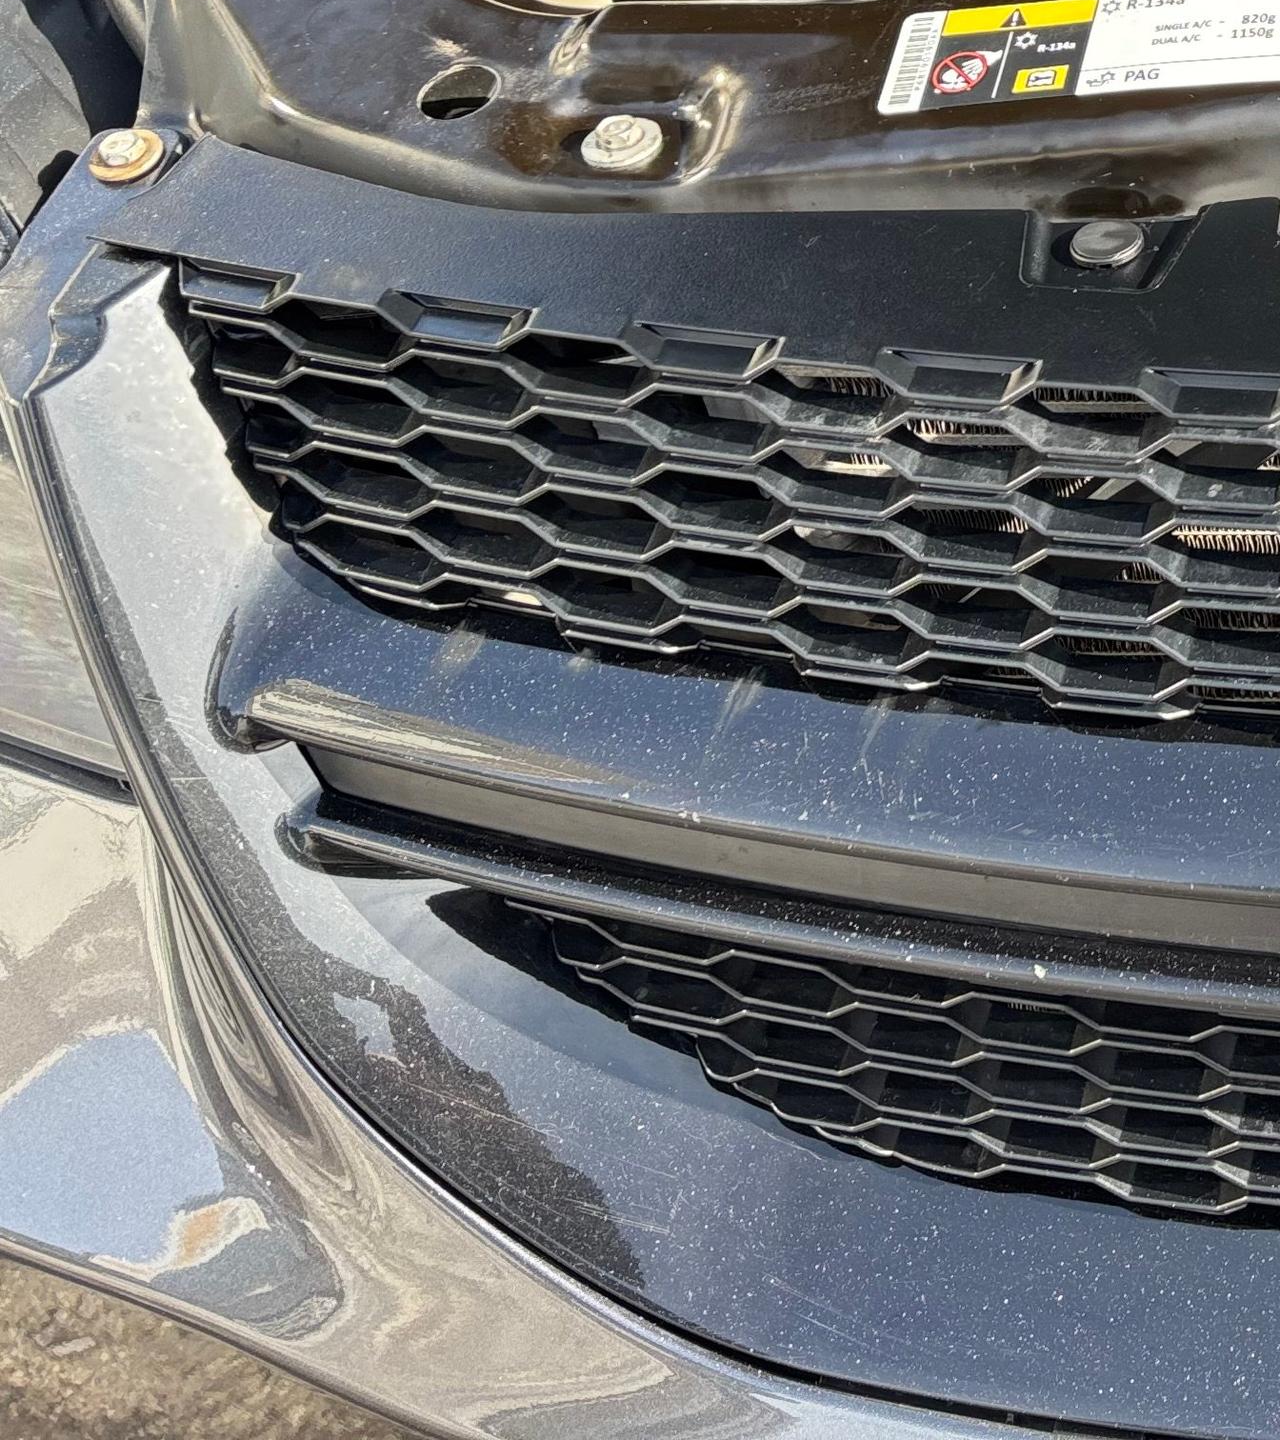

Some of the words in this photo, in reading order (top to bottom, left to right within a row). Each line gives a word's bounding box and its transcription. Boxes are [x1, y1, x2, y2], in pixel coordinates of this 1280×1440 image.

[1154, 22, 1191, 33] SINGLE
[1191, 19, 1212, 30] A/C
[1241, 12, 1276, 26] 820g
[1151, 35, 1179, 47] DUAL
[1180, 33, 1201, 44] A/C
[1231, 27, 1275, 40] 1150g
[1124, 68, 1161, 83] PAG
